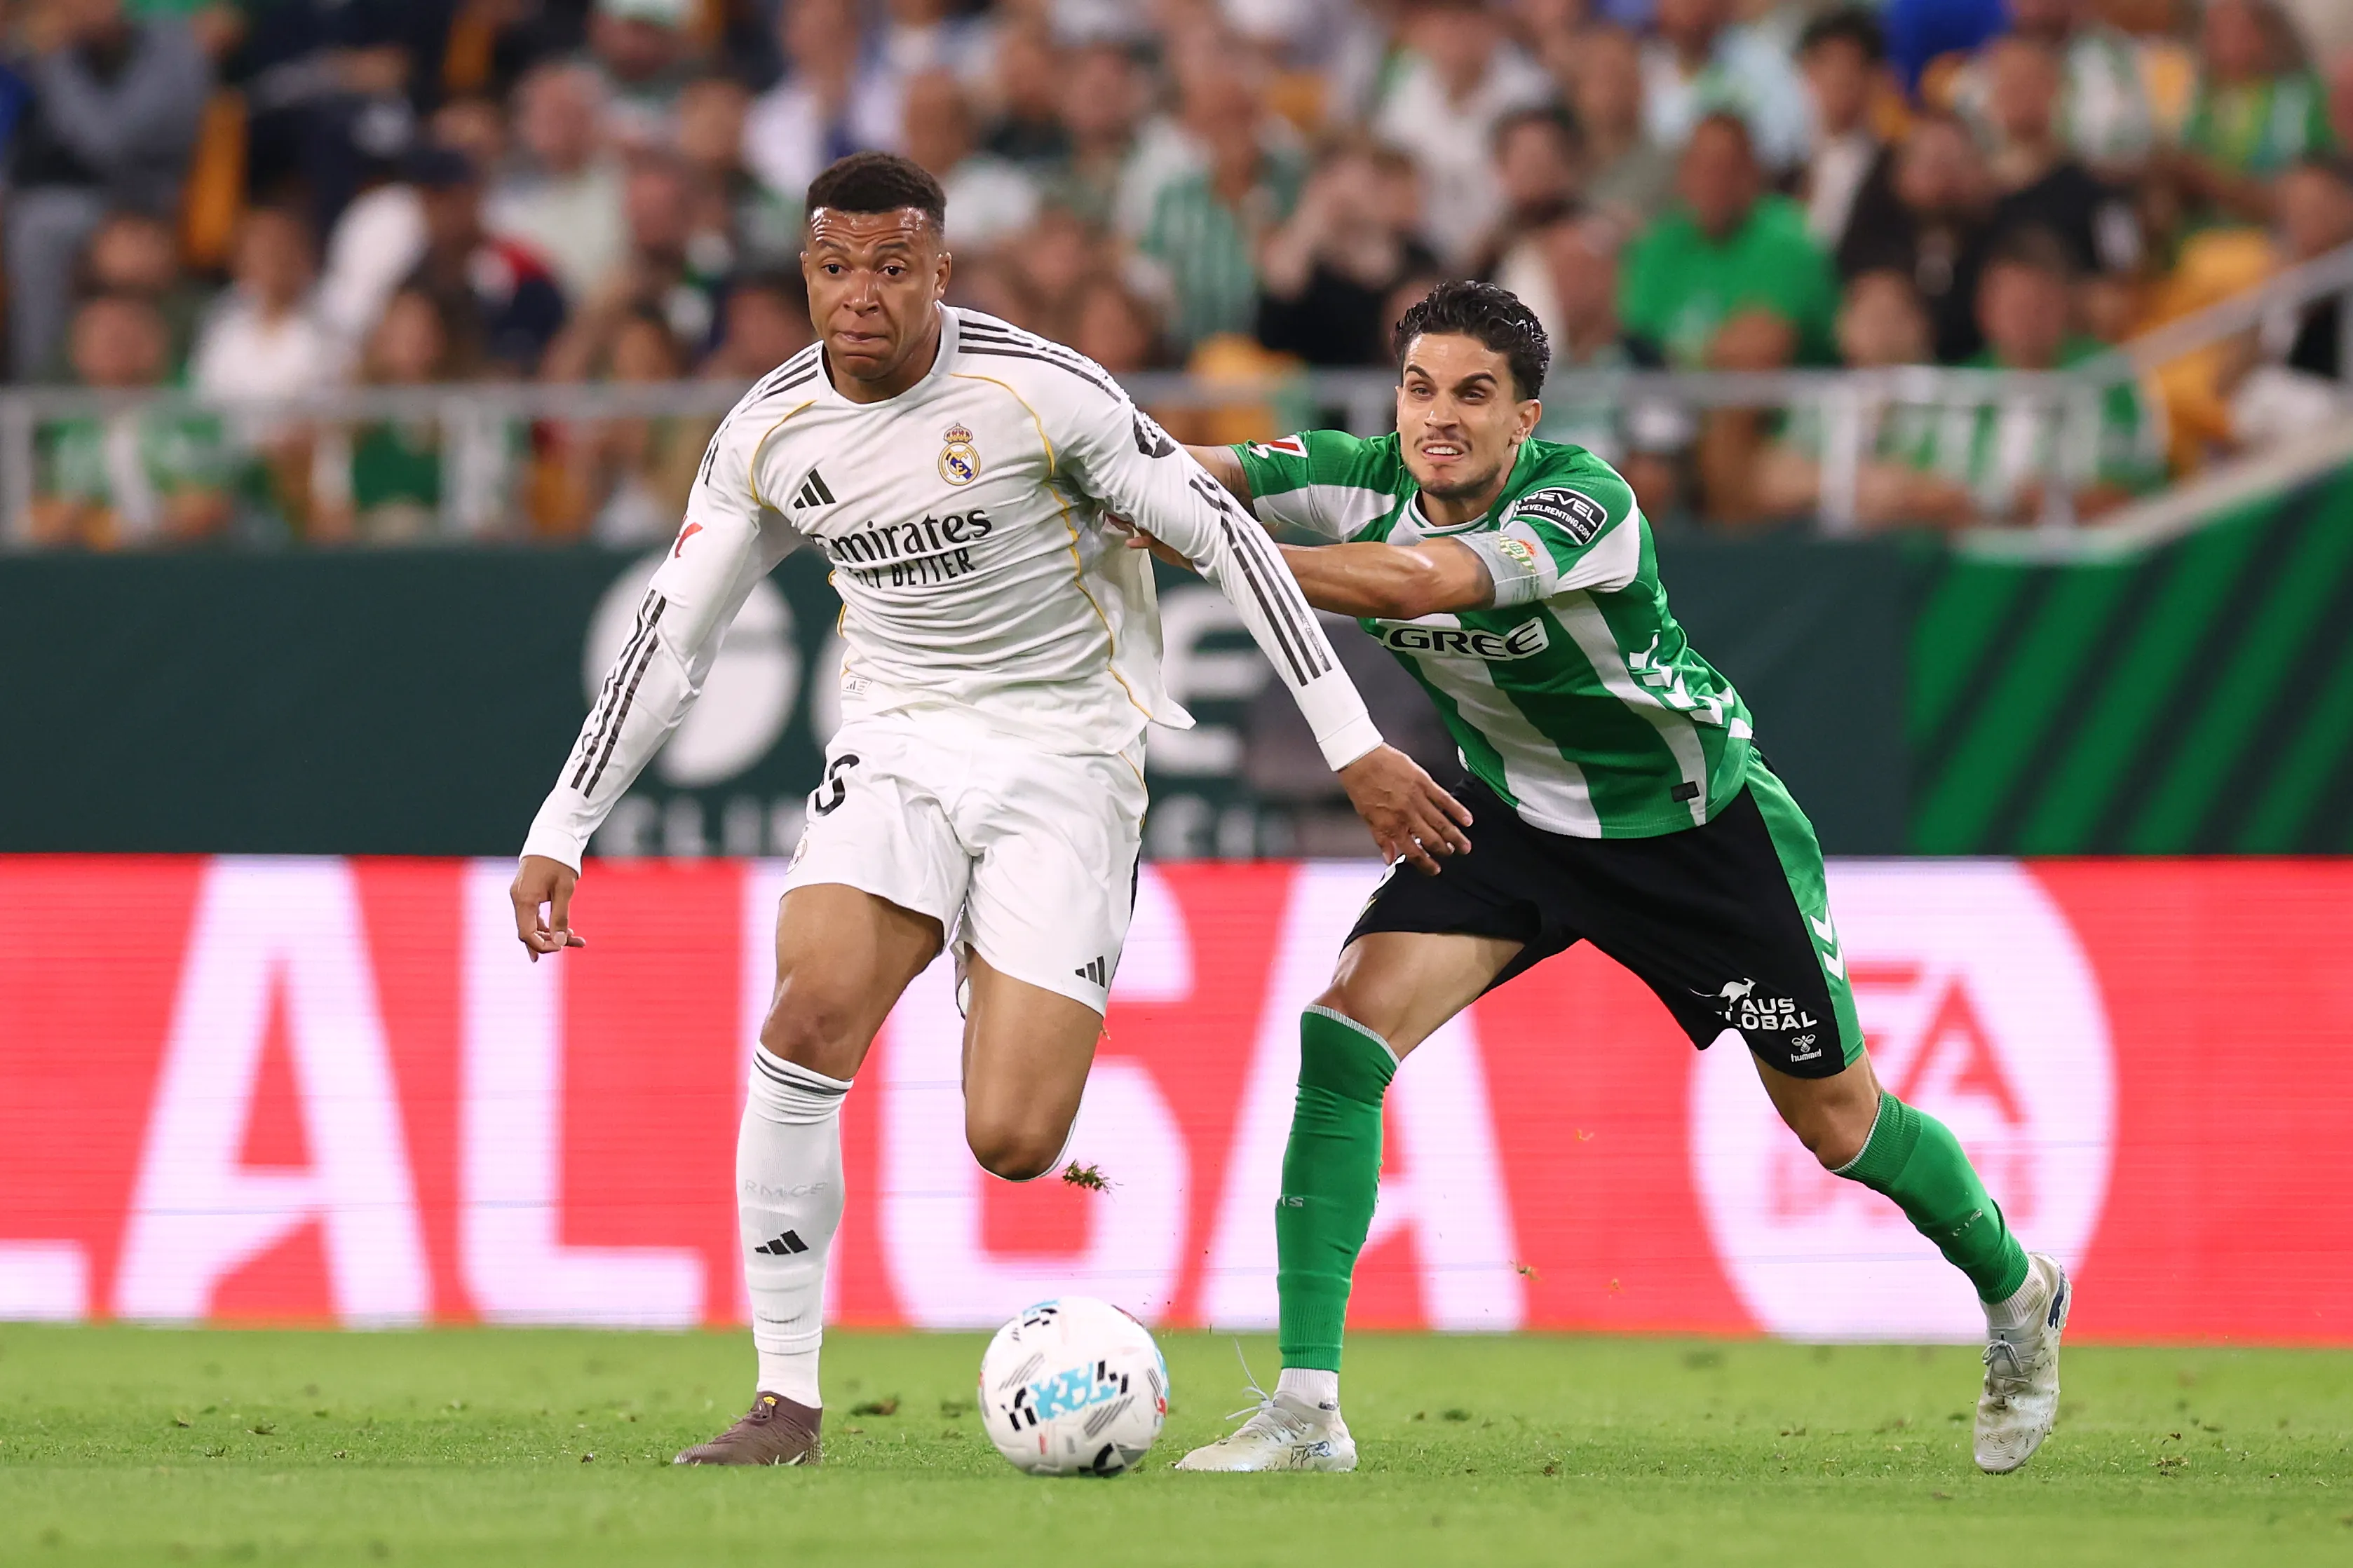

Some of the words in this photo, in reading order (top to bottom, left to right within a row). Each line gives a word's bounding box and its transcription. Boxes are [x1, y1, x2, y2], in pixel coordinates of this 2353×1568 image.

[1389, 623, 1544, 657] GREE
[1740, 997, 1796, 1016] AUS
[1714, 1011, 1818, 1031] LOBAL
[1790, 1048, 1822, 1063] hummel
[0, 859, 1527, 1329] ALGA
